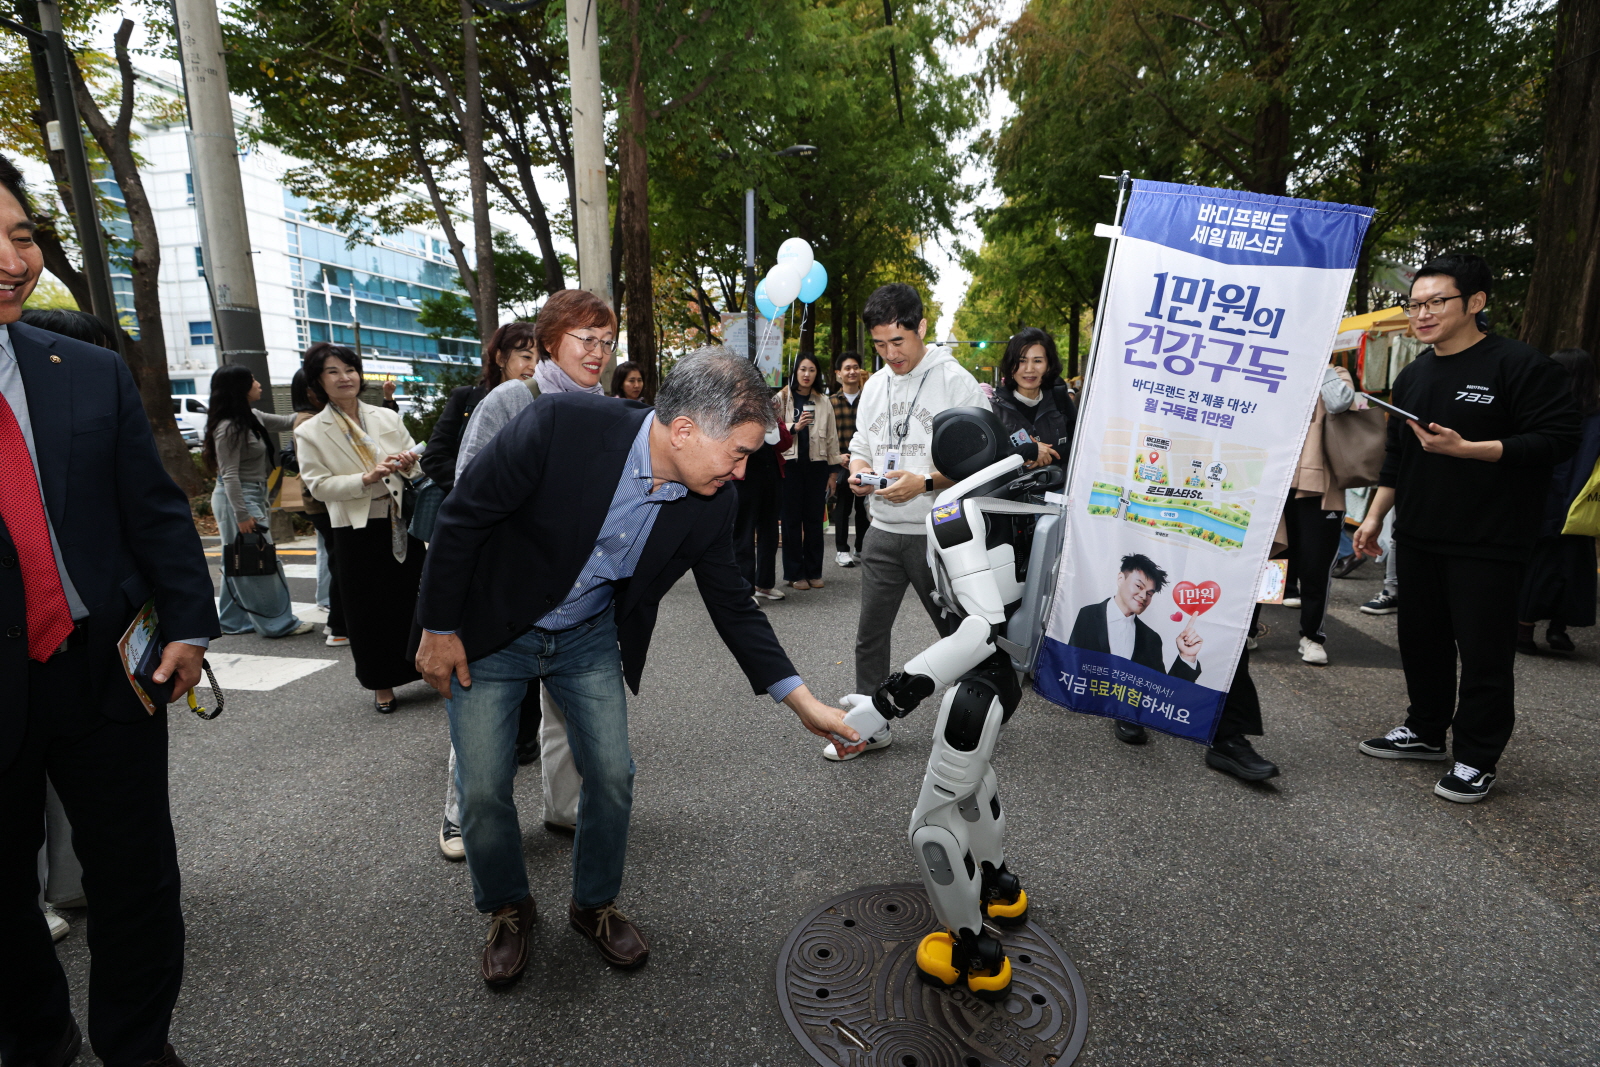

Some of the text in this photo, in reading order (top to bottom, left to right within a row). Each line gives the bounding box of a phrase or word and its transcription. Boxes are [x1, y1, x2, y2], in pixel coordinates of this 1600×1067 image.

[1197, 203, 1289, 233] 바디프랜드
[1190, 224, 1283, 256] 세일 페스타
[1144, 271, 1286, 339] 1만원의
[1124, 322, 1290, 394] 건강구독
[1132, 378, 1258, 414] 바디프랜드 전 제품 대상!
[1454, 391, 1495, 405] 733
[1144, 397, 1235, 429] 월 구독료 1만원
[1145, 485, 1204, 500] 로드페스타St.
[1178, 587, 1215, 605] 1만원
[1081, 663, 1175, 698] 바디프랜드 건강라운지에서!
[1058, 670, 1191, 725] 지금 무료체험하세요
